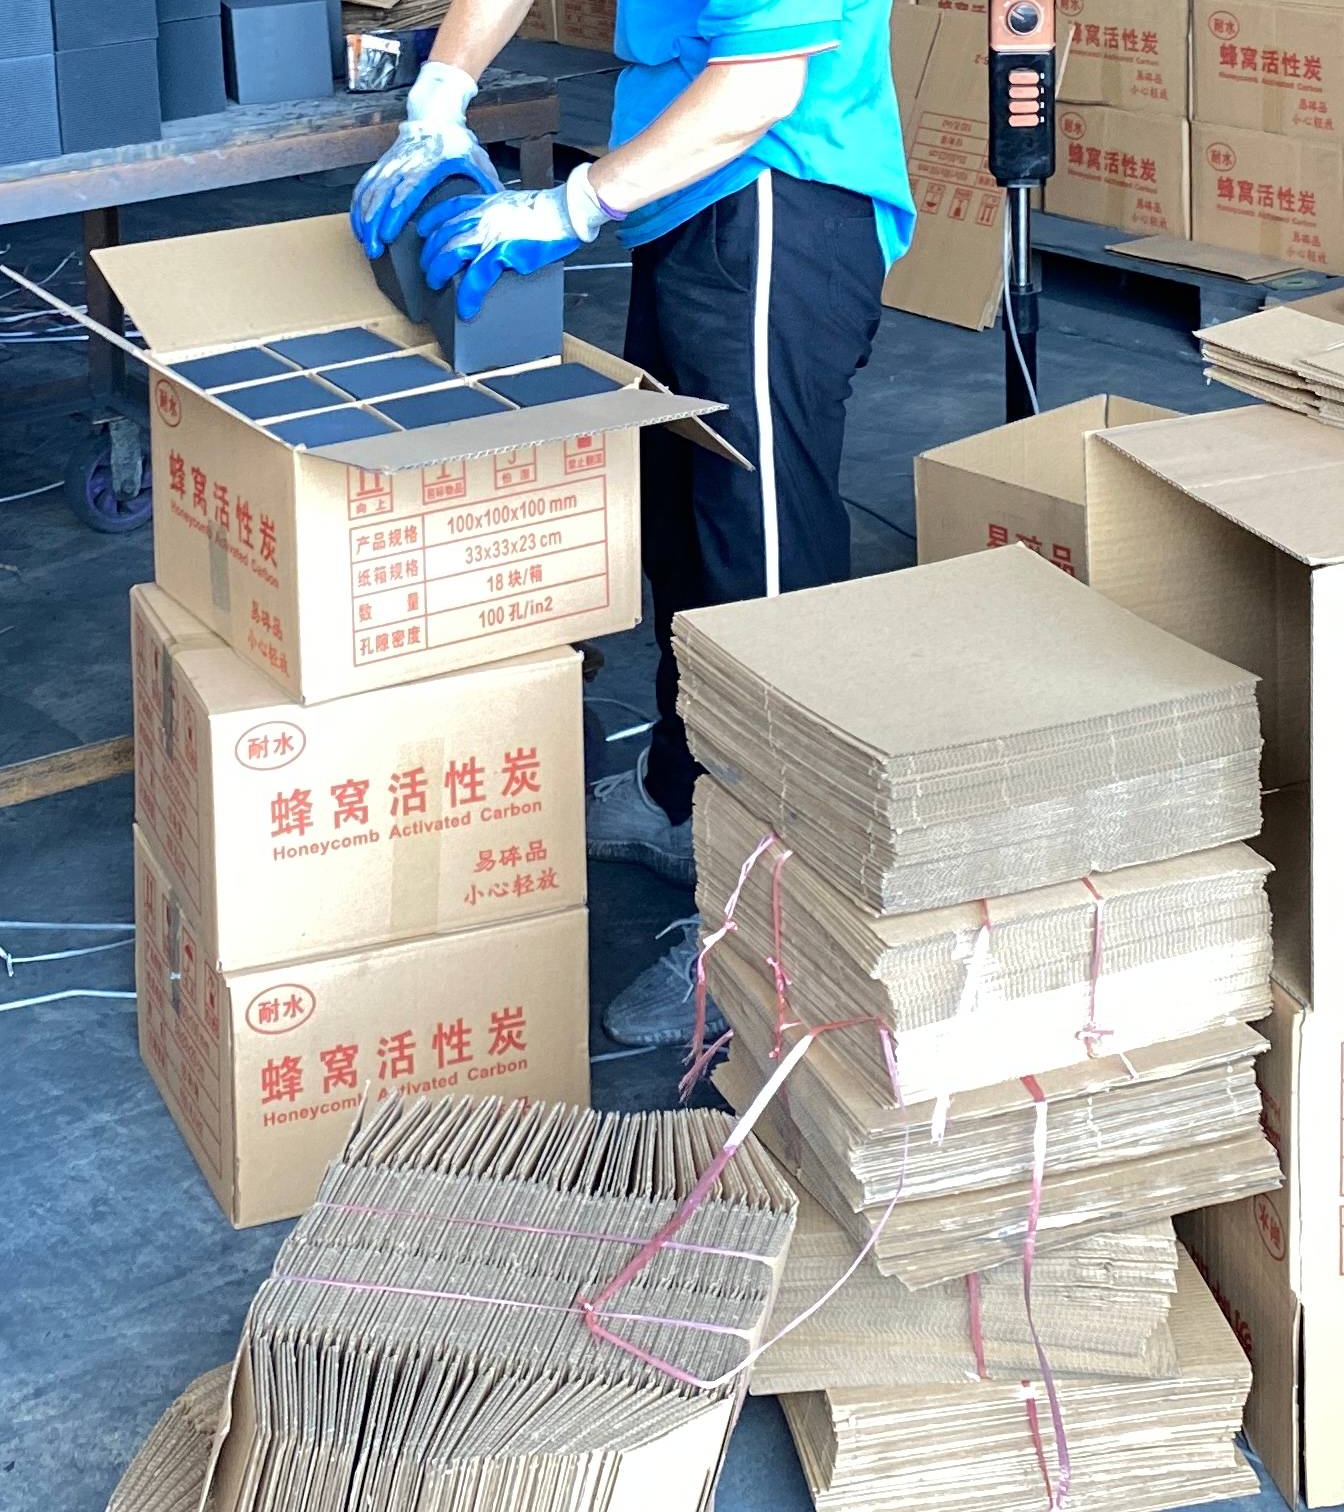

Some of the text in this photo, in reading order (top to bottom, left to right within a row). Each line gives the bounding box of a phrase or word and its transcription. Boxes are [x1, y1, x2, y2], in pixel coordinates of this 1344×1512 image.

[1216, 175, 1317, 219] 蜂窝活性炭
[169, 448, 277, 568] 蜂窝活性炭
[356, 494, 577, 554] 产品规格 100x100x100 mm
[358, 530, 562, 587] 纸箱规格 33x33x23 cm
[486, 564, 543, 592] 18 块/箱
[479, 607, 504, 628] 100
[248, 732, 294, 759] 耐水
[270, 747, 541, 839] 蜂窝活性炭
[273, 799, 541, 861] Honeycomb Activated Carbon
[474, 839, 547, 873] 易碎品
[463, 867, 560, 905] 小心轻放
[258, 995, 304, 1024] 耐水
[261, 1006, 528, 1105] 蜂窝活性炭
[467, 1058, 528, 1081] Carbon
